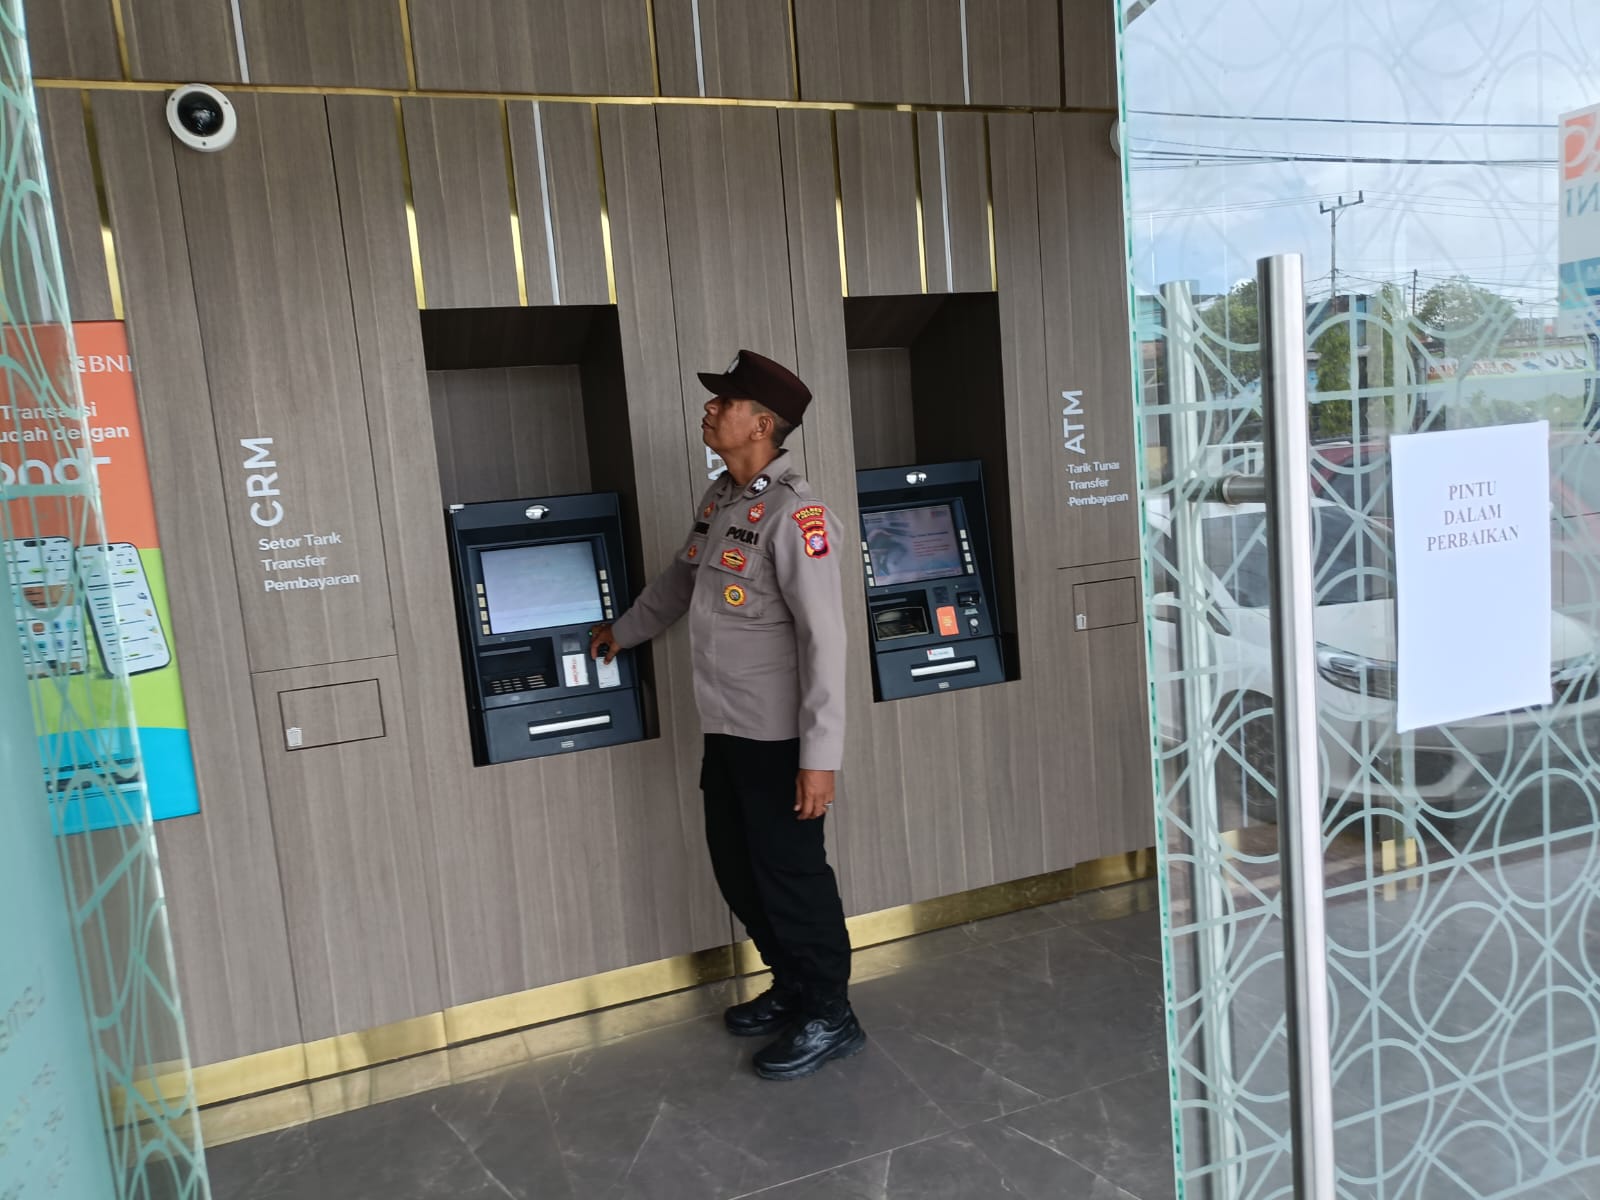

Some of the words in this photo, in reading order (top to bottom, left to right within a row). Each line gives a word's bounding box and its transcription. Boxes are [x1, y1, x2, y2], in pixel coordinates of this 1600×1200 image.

[88, 354, 132, 373] BNI
[1061, 390, 1086, 455] ATM
[54, 425, 129, 443] degan
[240, 437, 284, 527] CRM
[1068, 477, 1110, 491] Transfer
[1448, 481, 1496, 501] PINTU
[1068, 492, 1129, 507] Pembayaran
[1443, 503, 1502, 526] DALAM
[258, 536, 302, 551] Setor
[726, 526, 760, 546] POLRI
[1426, 525, 1520, 552] PERBAIKAN
[260, 555, 328, 572] Transfer
[264, 574, 360, 592] Pembayaran
